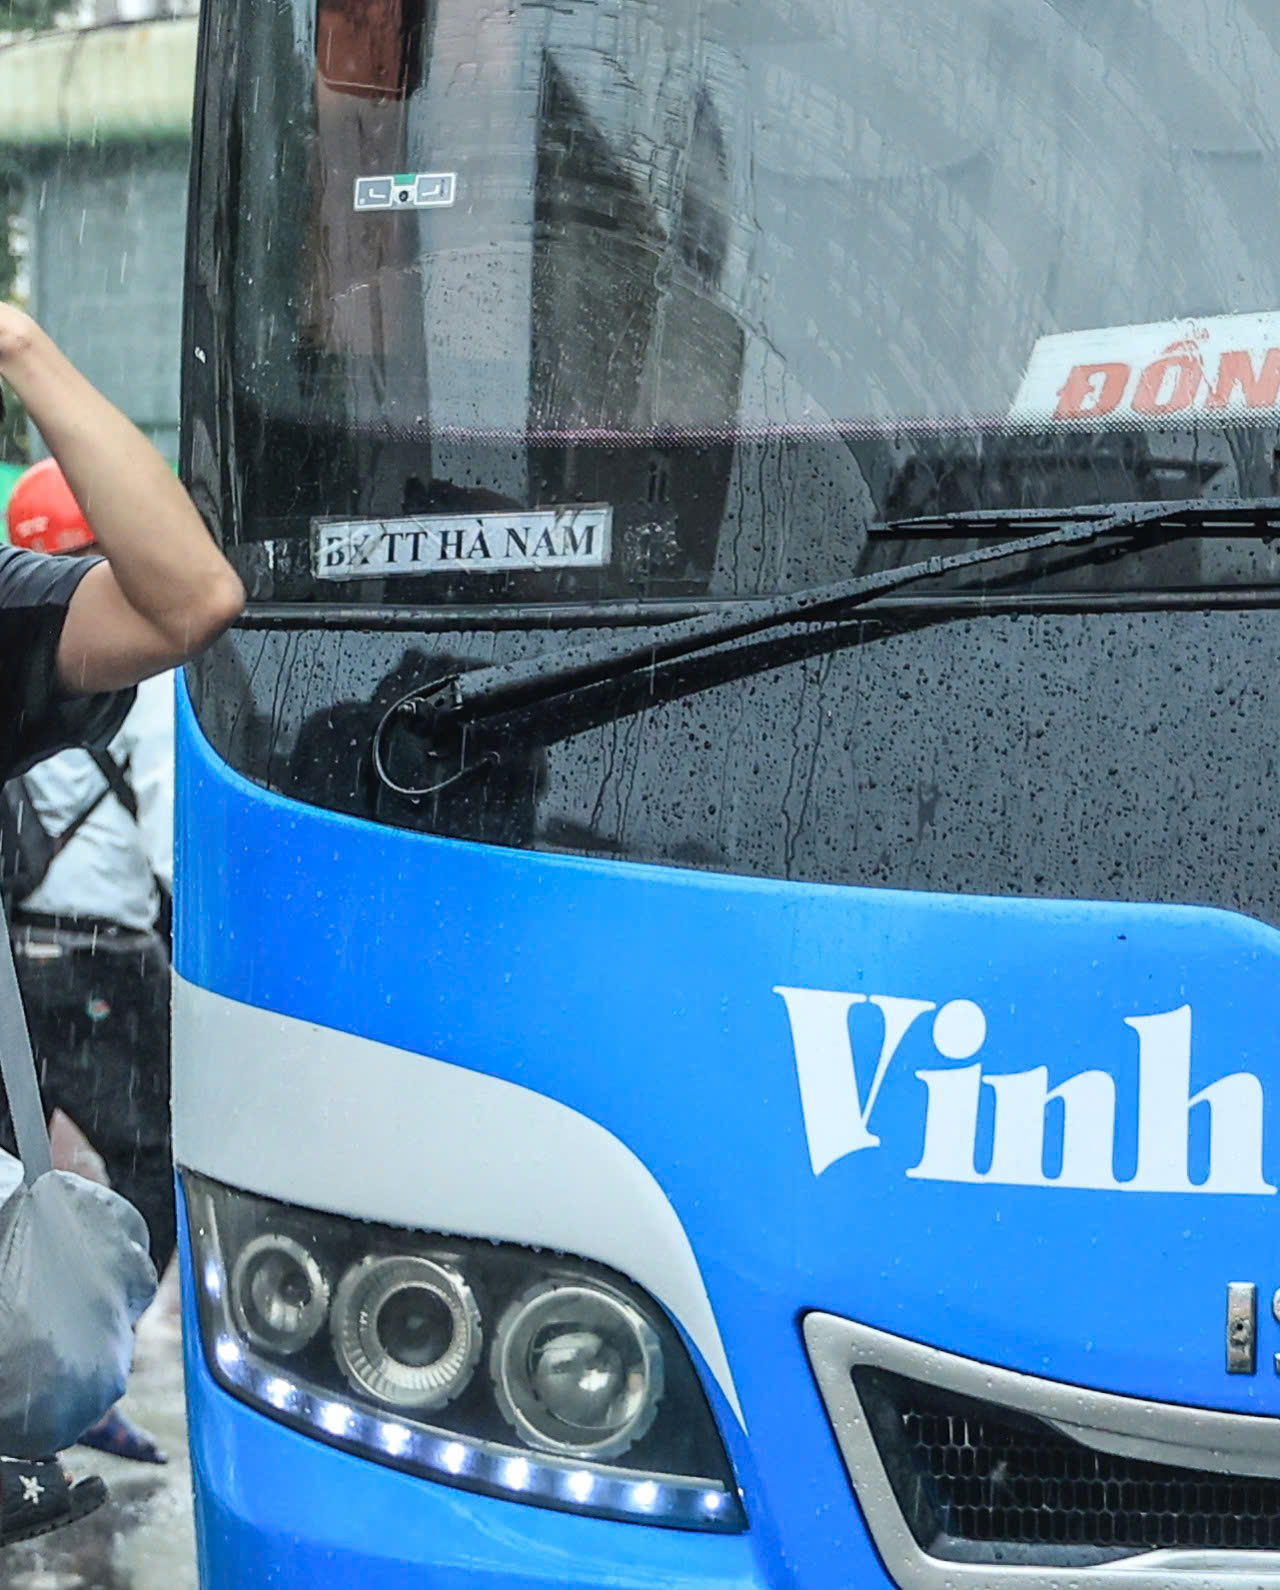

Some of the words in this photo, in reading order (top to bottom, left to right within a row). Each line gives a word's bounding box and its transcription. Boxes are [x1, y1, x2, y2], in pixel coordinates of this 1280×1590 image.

[380, 531, 428, 563] TT
[437, 519, 492, 561] HÀ
[504, 524, 597, 559] NAM
[772, 985, 1278, 1195] Vinh
